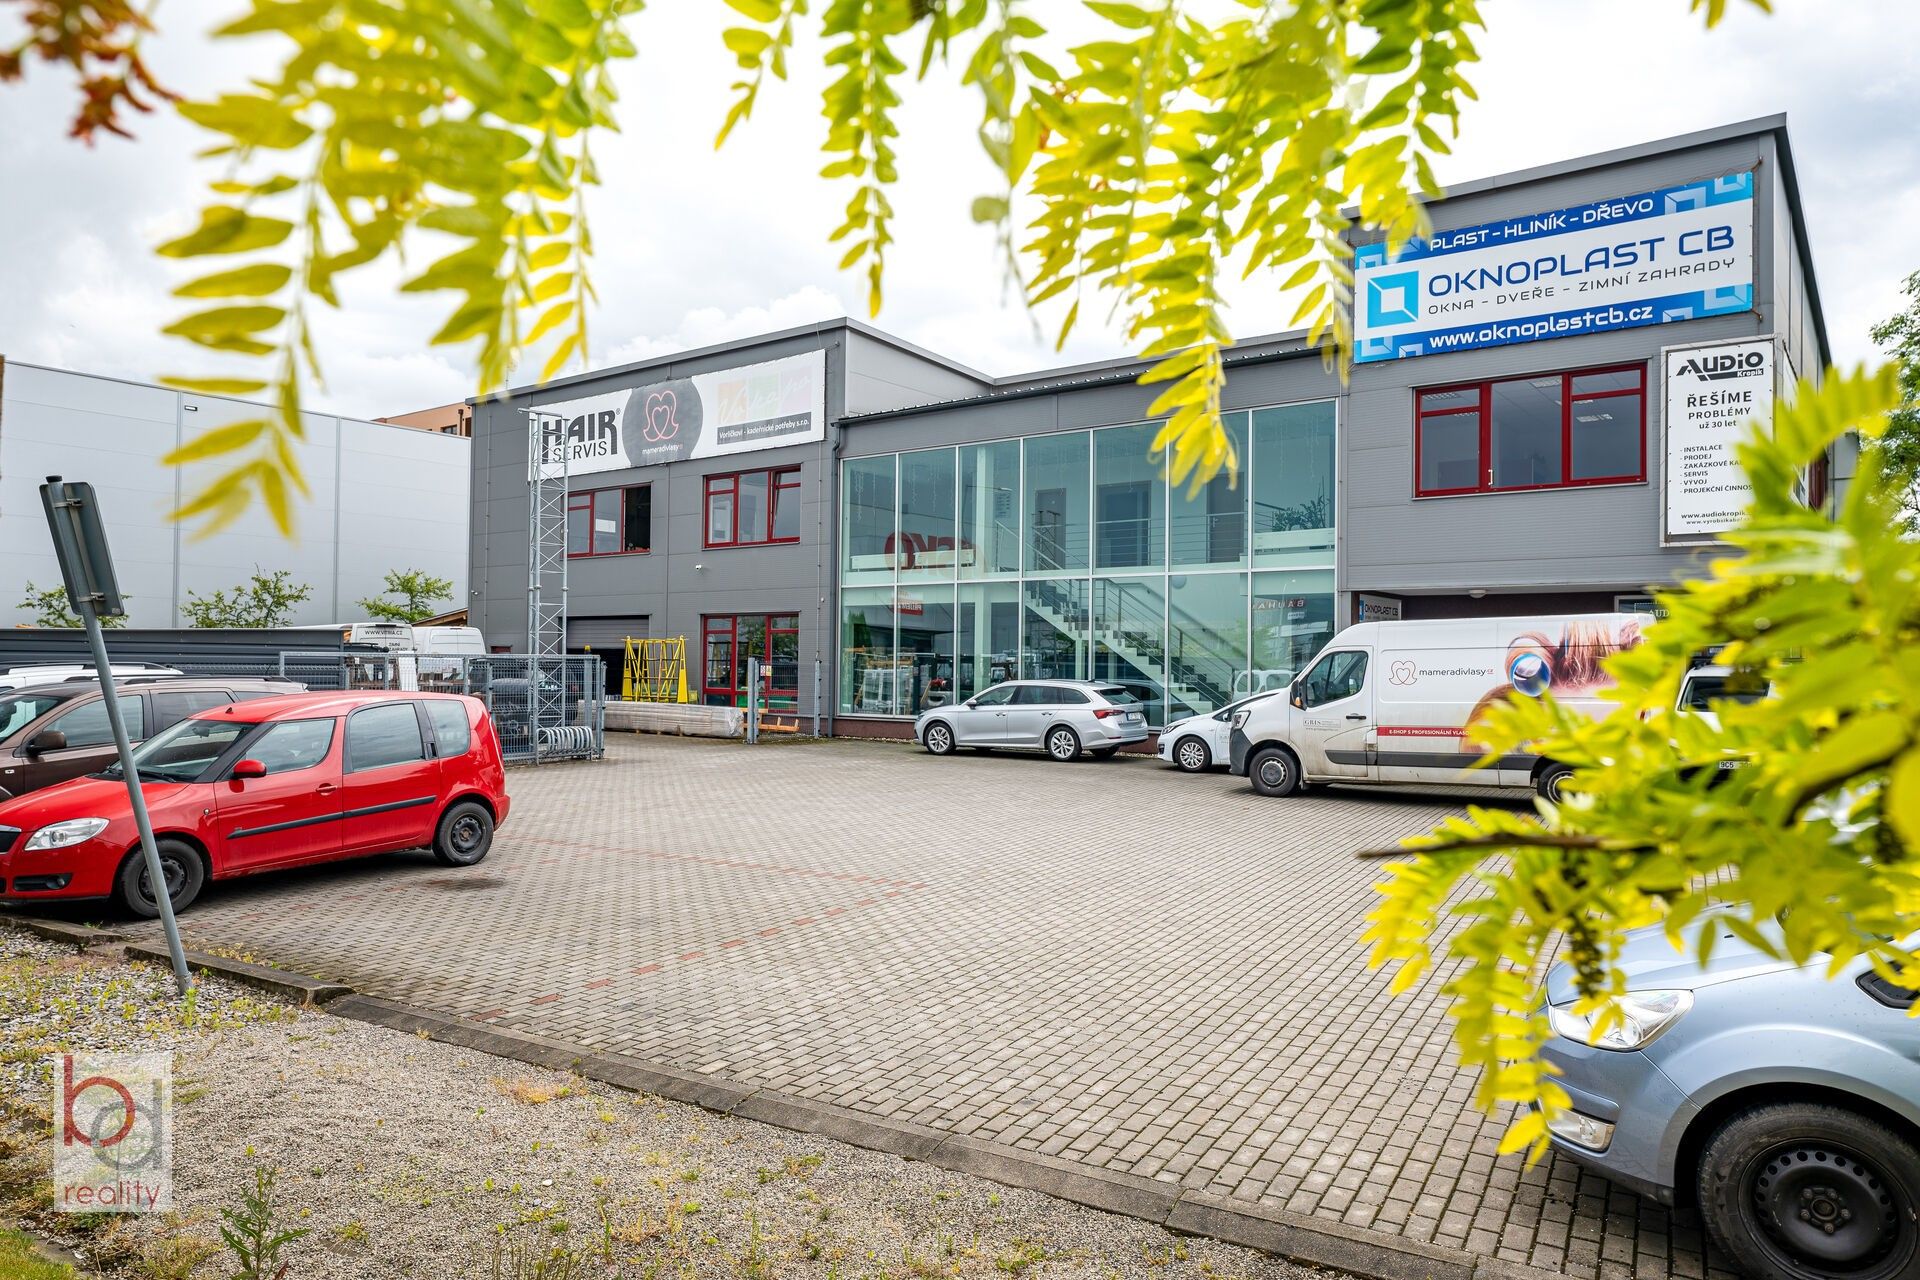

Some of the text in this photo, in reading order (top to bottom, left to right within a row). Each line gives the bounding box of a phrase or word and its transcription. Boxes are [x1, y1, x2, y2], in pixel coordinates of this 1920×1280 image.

[1430, 230, 1489, 251] PLAST
[1504, 213, 1566, 238] HLINÍK
[1583, 198, 1653, 223] DŘEVO
[1428, 225, 1734, 296] OKNOPLAST CB
[1428, 299, 1474, 315] OKNA
[1496, 286, 1555, 305] DVEŘE
[1578, 271, 1631, 292] ZIMNÍ
[1638, 257, 1735, 283] ZAHRADY
[1429, 306, 1653, 348] www.oknoplastcb.cz
[1687, 389, 1752, 408] ŘEŠÍME
[1688, 406, 1751, 420] PROBLÉMY
[1699, 419, 1737, 429] už 30 let
[541, 409, 618, 464] HAIR
[1683, 444, 1723, 453] INSTALACE
[1683, 453, 1712, 461] PRODEJ
[1683, 460, 1728, 469] ZAKÁZKOVÉ
[1683, 470, 1709, 478] SERVIS
[1683, 484, 1753, 494] PROJEKČNÍ ČINNOS
[1681, 510, 1749, 519] www.audiokropik
[1649, 609, 1669, 617] AUD
[1419, 668, 1487, 677] mameradivlasy
